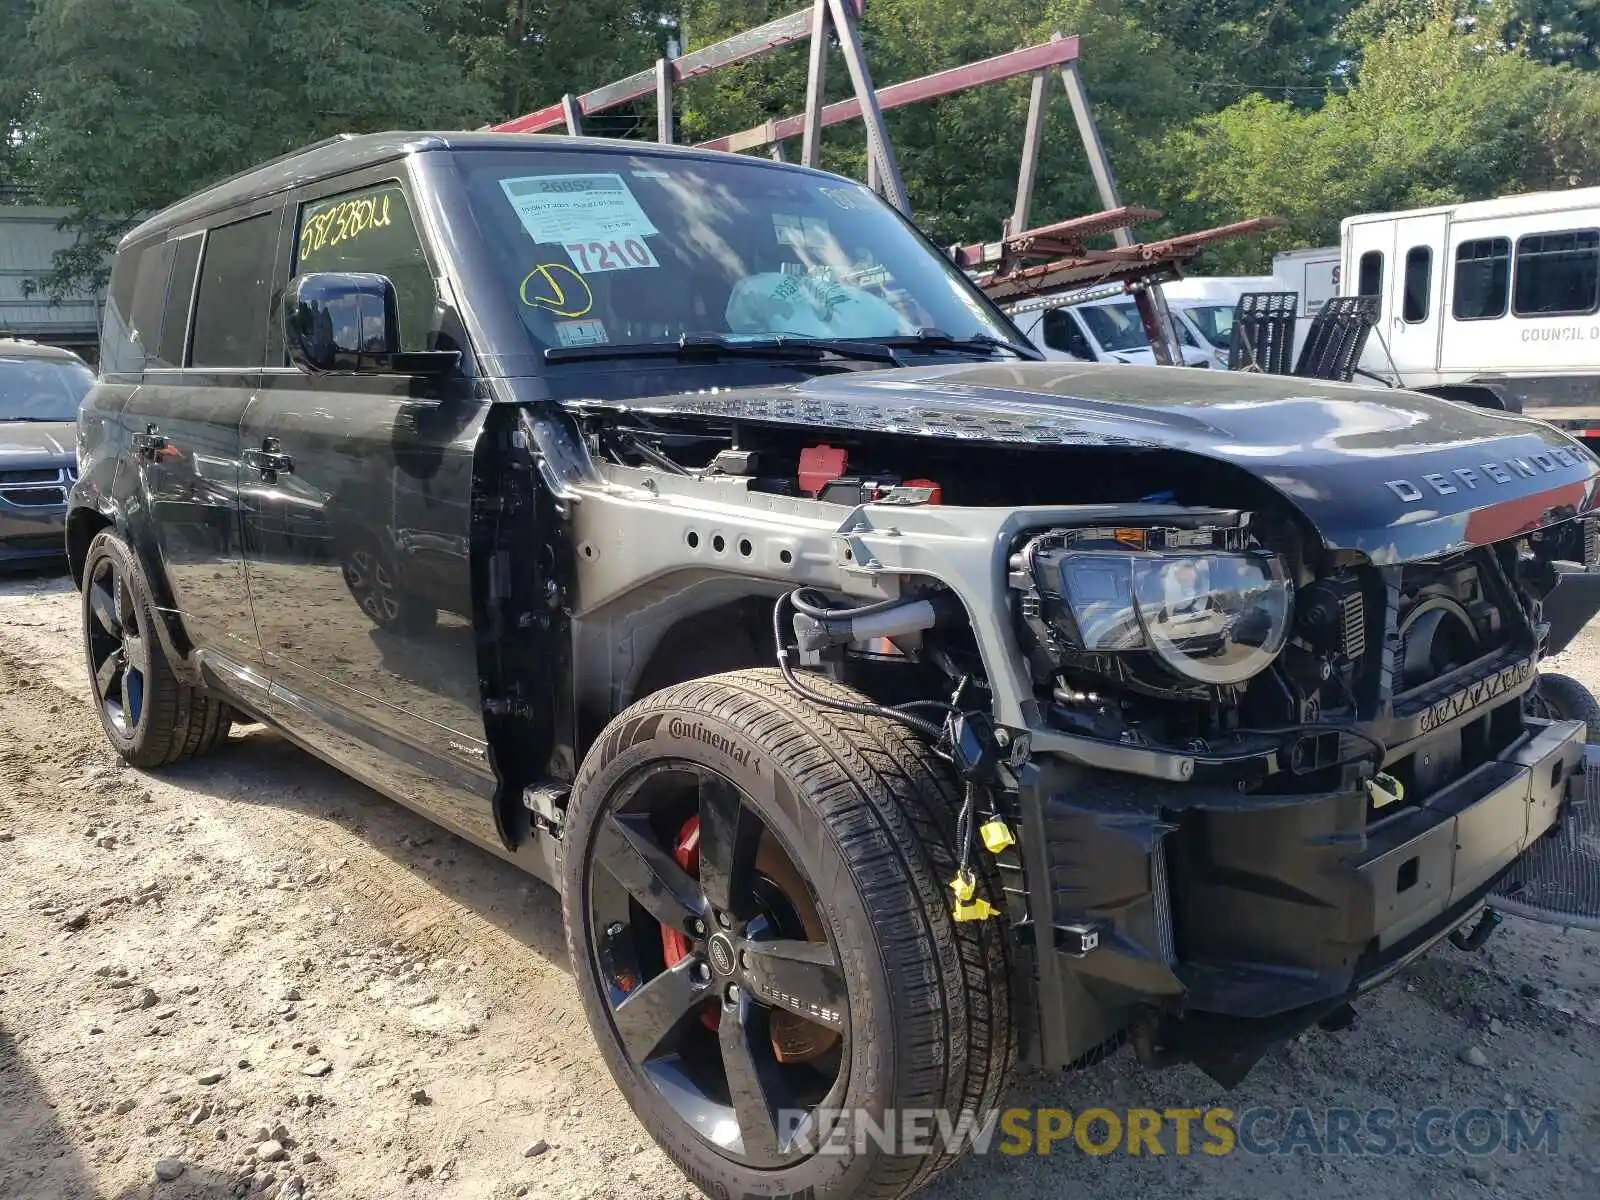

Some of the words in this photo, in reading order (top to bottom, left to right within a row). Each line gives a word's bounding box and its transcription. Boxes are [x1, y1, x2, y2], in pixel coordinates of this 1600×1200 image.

[566, 239, 651, 272] 7210
[1521, 326, 1584, 342] COUNCIL
[1384, 445, 1591, 503] DEFENDER
[668, 716, 752, 767] Continental
